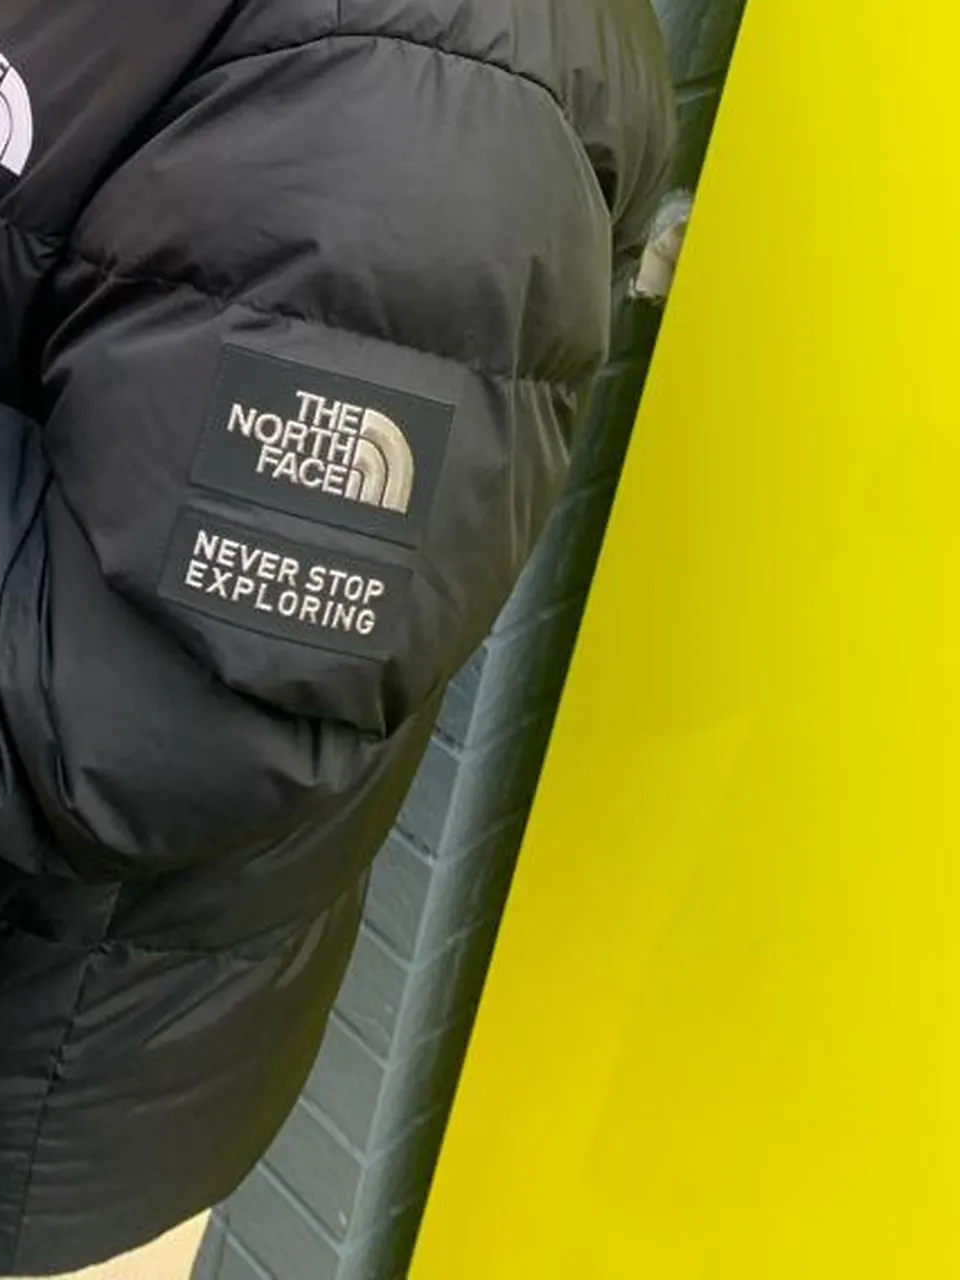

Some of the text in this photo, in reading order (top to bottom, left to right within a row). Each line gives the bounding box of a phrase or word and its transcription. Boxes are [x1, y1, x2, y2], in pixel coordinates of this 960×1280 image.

[227, 403, 355, 466] NORTH
[296, 390, 362, 435] THE
[256, 445, 347, 495] FACE
[185, 560, 376, 635] EXPLORING
[193, 530, 385, 606] NEVER STOP
